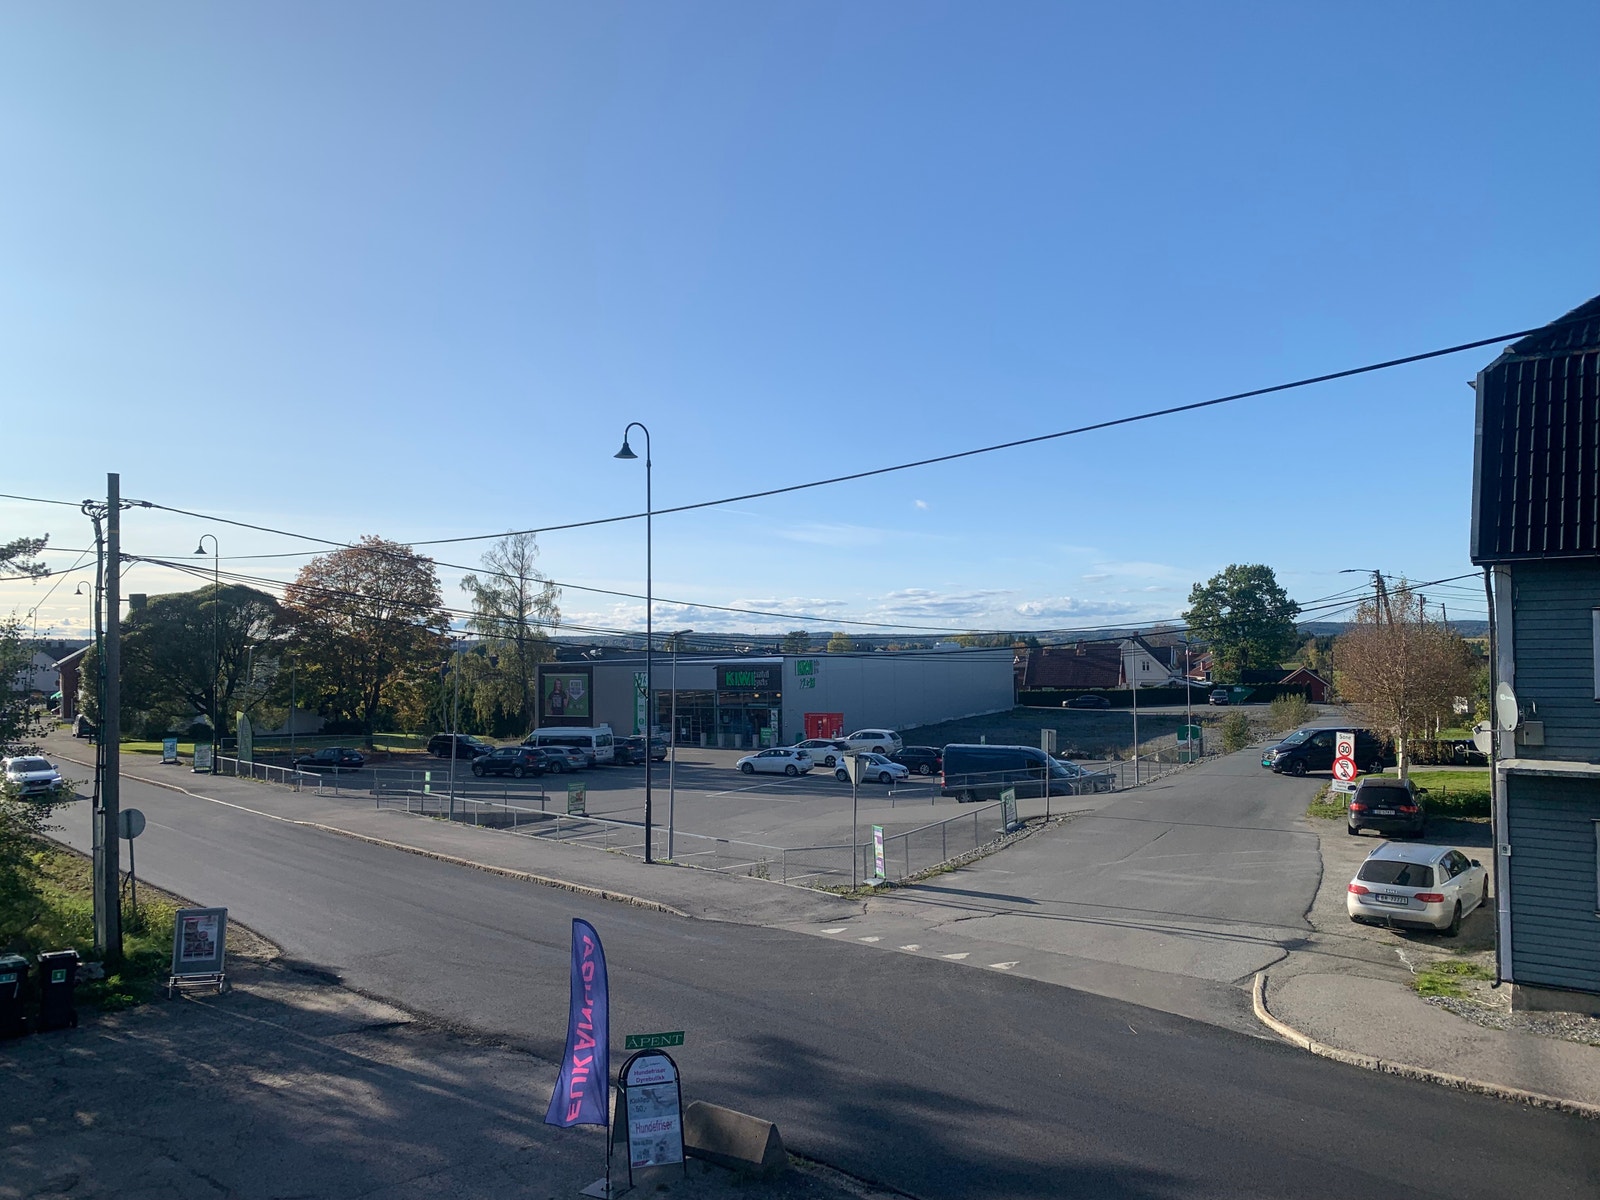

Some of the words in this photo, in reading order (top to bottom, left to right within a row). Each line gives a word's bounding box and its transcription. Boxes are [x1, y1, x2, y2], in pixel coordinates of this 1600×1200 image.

[726, 671, 754, 686] KIWI
[1341, 745, 1350, 754] 30
[627, 1035, 682, 1048] ÅPENT
[635, 1120, 673, 1135] Hundefriser
